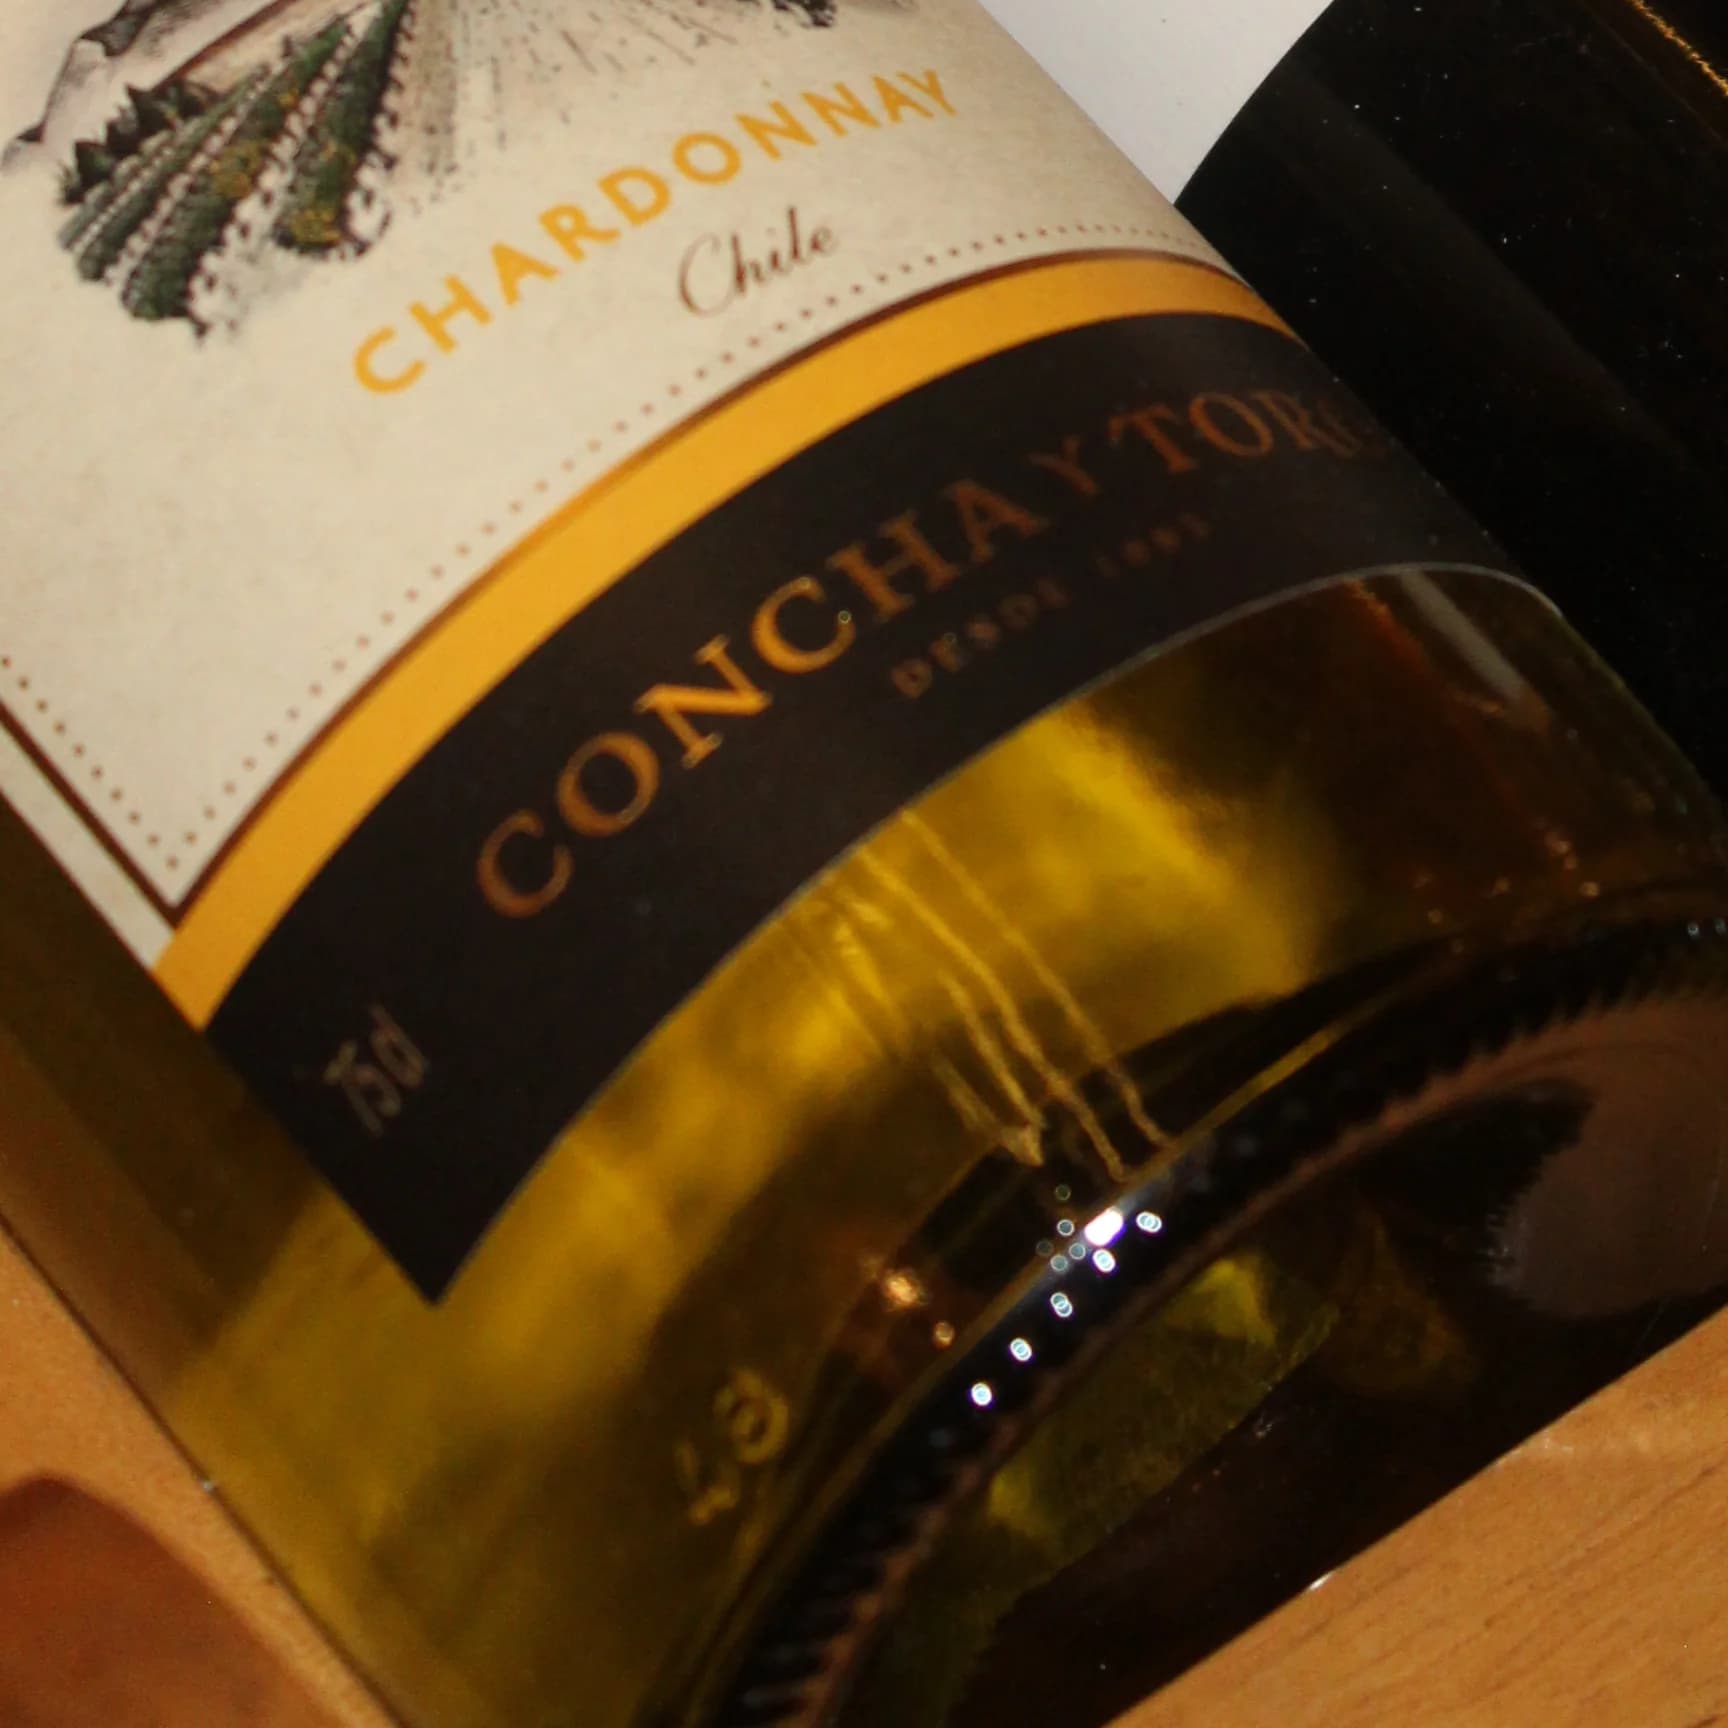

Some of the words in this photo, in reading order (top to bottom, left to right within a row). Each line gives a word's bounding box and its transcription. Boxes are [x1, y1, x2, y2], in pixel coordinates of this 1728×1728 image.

[353, 69, 957, 395] CHARDONNAY
[677, 205, 839, 318] Chile
[475, 478, 1048, 918] CONCHA
